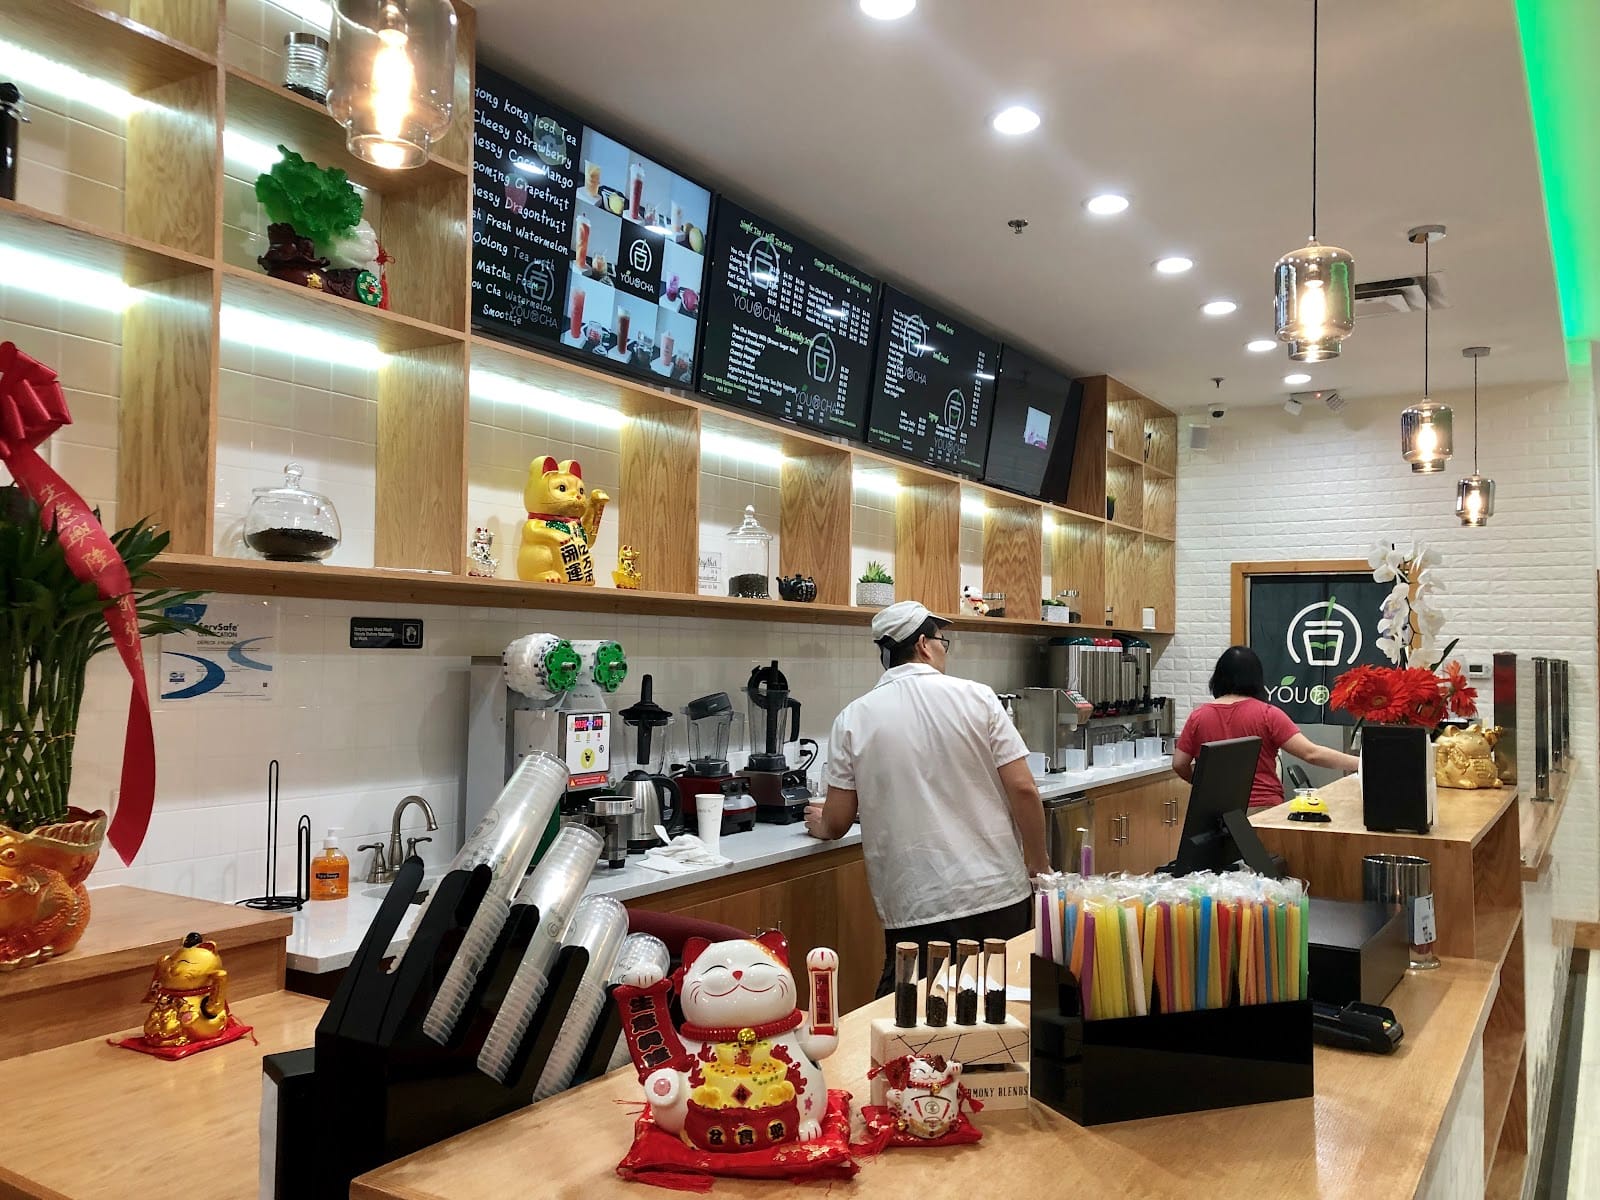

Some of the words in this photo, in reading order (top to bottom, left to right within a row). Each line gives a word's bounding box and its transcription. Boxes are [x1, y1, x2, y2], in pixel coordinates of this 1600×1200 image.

[534, 114, 556, 135] Iced
[560, 127, 577, 146] Tea
[515, 130, 572, 169] Strawberry
[473, 161, 510, 186] ooming
[515, 177, 570, 212] Grapefruit
[541, 165, 574, 188] Mango
[504, 197, 567, 233] Dragonfruit
[485, 213, 512, 233] Fresh
[515, 227, 569, 256] Watermelon
[513, 246, 530, 262] Tea
[475, 259, 512, 281] Matcha
[472, 281, 482, 290] ou
[485, 283, 502, 297] Cha
[482, 304, 522, 326] Smoothie
